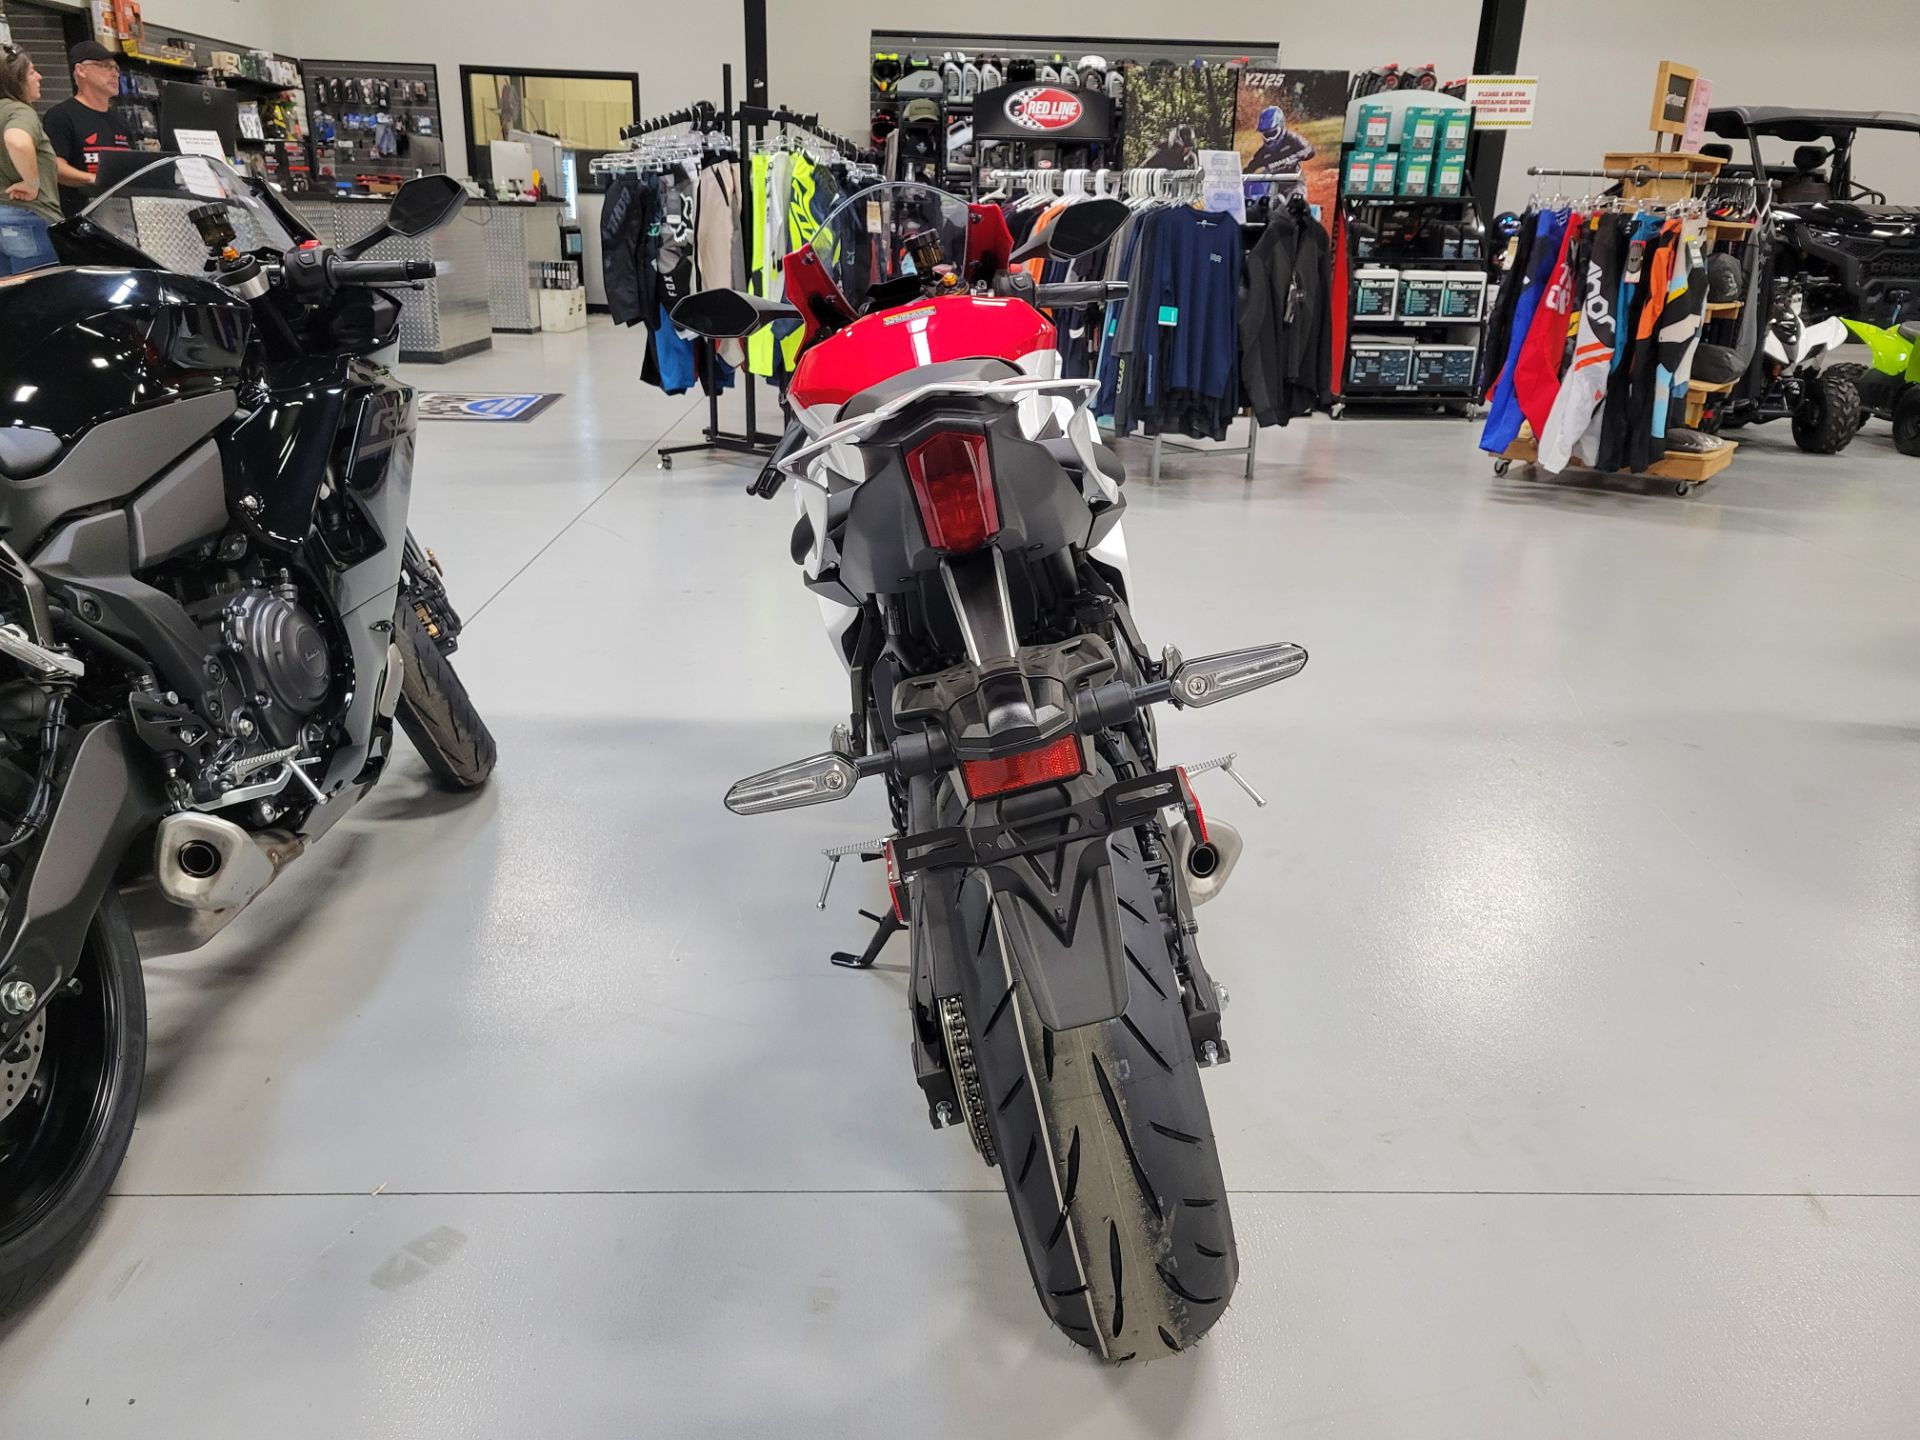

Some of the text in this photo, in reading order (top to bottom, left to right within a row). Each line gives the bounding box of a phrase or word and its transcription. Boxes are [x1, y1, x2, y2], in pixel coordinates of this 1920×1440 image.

[1244, 72, 1285, 86] YZ125
[1027, 100, 1078, 115] RED LINE
[663, 274, 678, 297] FOX
